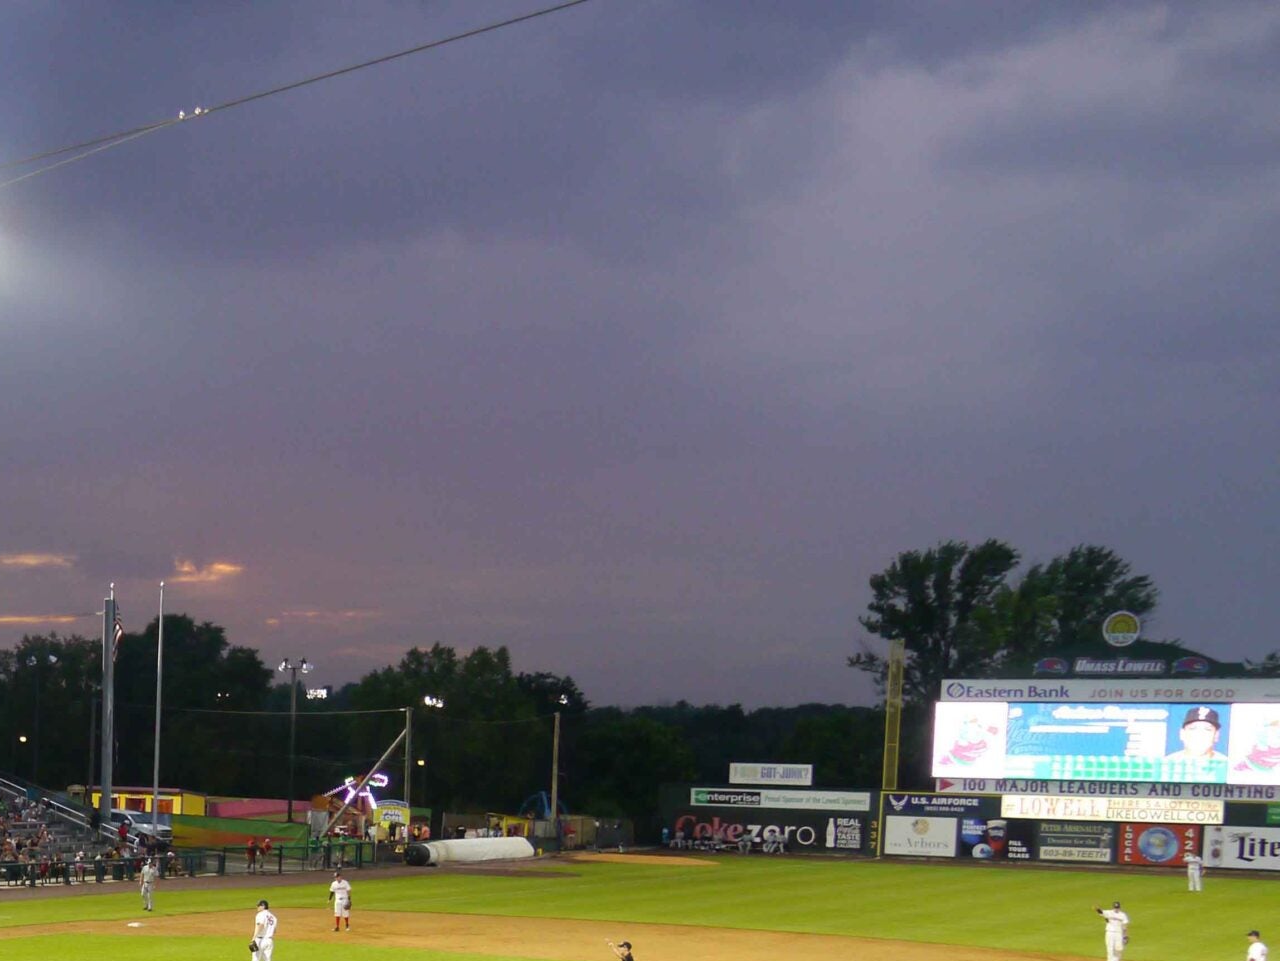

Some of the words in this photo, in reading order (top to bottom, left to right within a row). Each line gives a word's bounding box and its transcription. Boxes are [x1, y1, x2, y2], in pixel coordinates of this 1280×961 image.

[966, 685, 1024, 698] Eastern
[1027, 684, 1070, 698] Bank
[1090, 689, 1123, 698] JOIN
[1129, 689, 1148, 698] US
[1154, 689, 1184, 698] FOR
[1190, 688, 1235, 698] GOOD
[962, 779, 987, 791] 100
[995, 781, 1050, 793] MAJOR
[1058, 782, 1139, 796] LEAGUERS
[1148, 784, 1182, 797] AND
[1191, 784, 1275, 799] COUNTING
[695, 792, 760, 804] enterprise
[911, 797, 929, 805] U.S.
[1105, 809, 1220, 822] LIKELOWELL.COM
[837, 818, 861, 826] REAL
[675, 815, 744, 842] Coke
[747, 824, 816, 845] zero
[907, 837, 949, 849] Arbors
